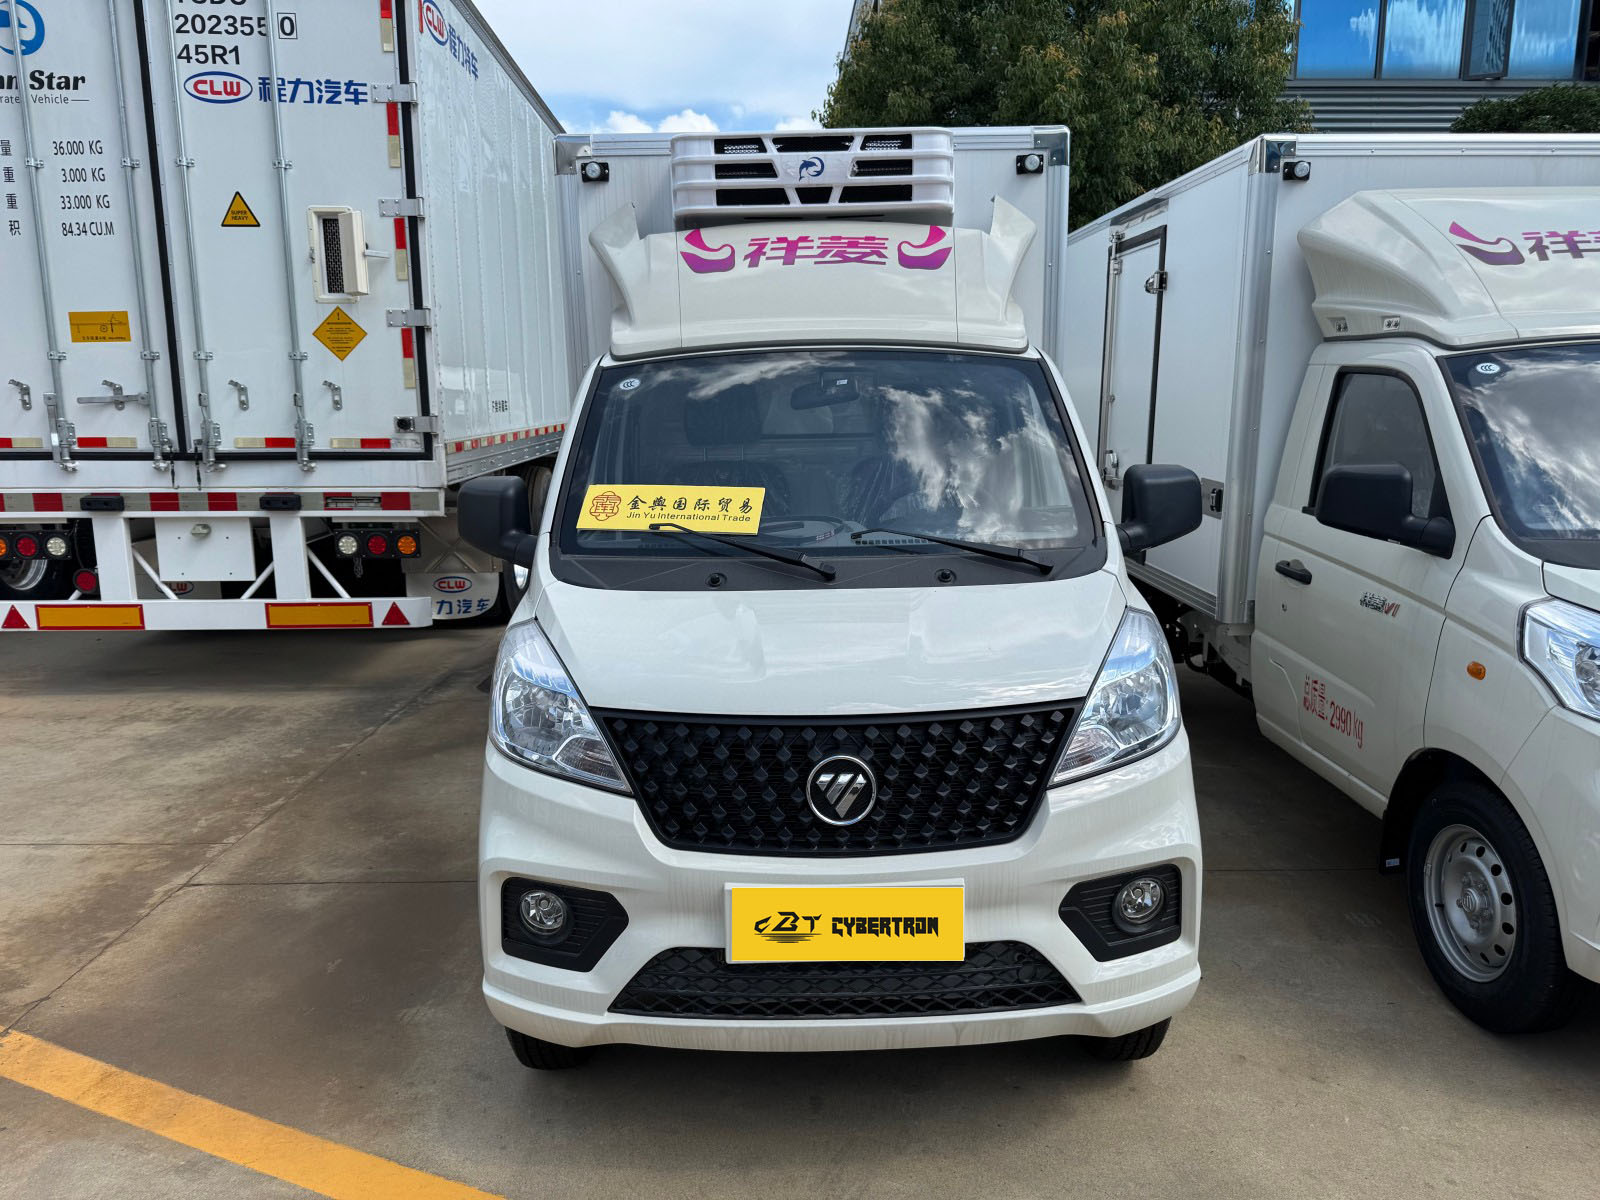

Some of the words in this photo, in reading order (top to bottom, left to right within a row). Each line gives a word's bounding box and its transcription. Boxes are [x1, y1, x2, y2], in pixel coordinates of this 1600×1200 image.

[175, 14, 268, 37] 202355
[279, 16, 295, 37] 0
[426, 4, 445, 40] CLW
[176, 43, 241, 65] 45R1
[29, 69, 86, 91] Star
[193, 79, 241, 97] CLW
[31, 94, 70, 105] Vehicle
[257, 76, 368, 105] 程力汽车
[52, 140, 85, 156] 36.000
[88, 139, 104, 155] KG
[3, 166, 16, 183] 重
[61, 167, 88, 183] 3.000
[91, 167, 106, 182] KG
[5, 193, 18, 209] 重
[60, 194, 93, 210] 33.000
[95, 194, 111, 209] KG
[8, 220, 21, 236] 积
[61, 221, 88, 237] 84.34
[89, 221, 115, 236] CU.M
[743, 235, 889, 268] 祥菱
[1521, 230, 1600, 262] 祥
[626, 511, 641, 519] Jin
[643, 511, 656, 519] Yu
[657, 512, 720, 522] International
[722, 514, 751, 522] Trade
[437, 579, 466, 590] CLW
[1329, 700, 1352, 737] 2990
[1352, 709, 1364, 749] kg
